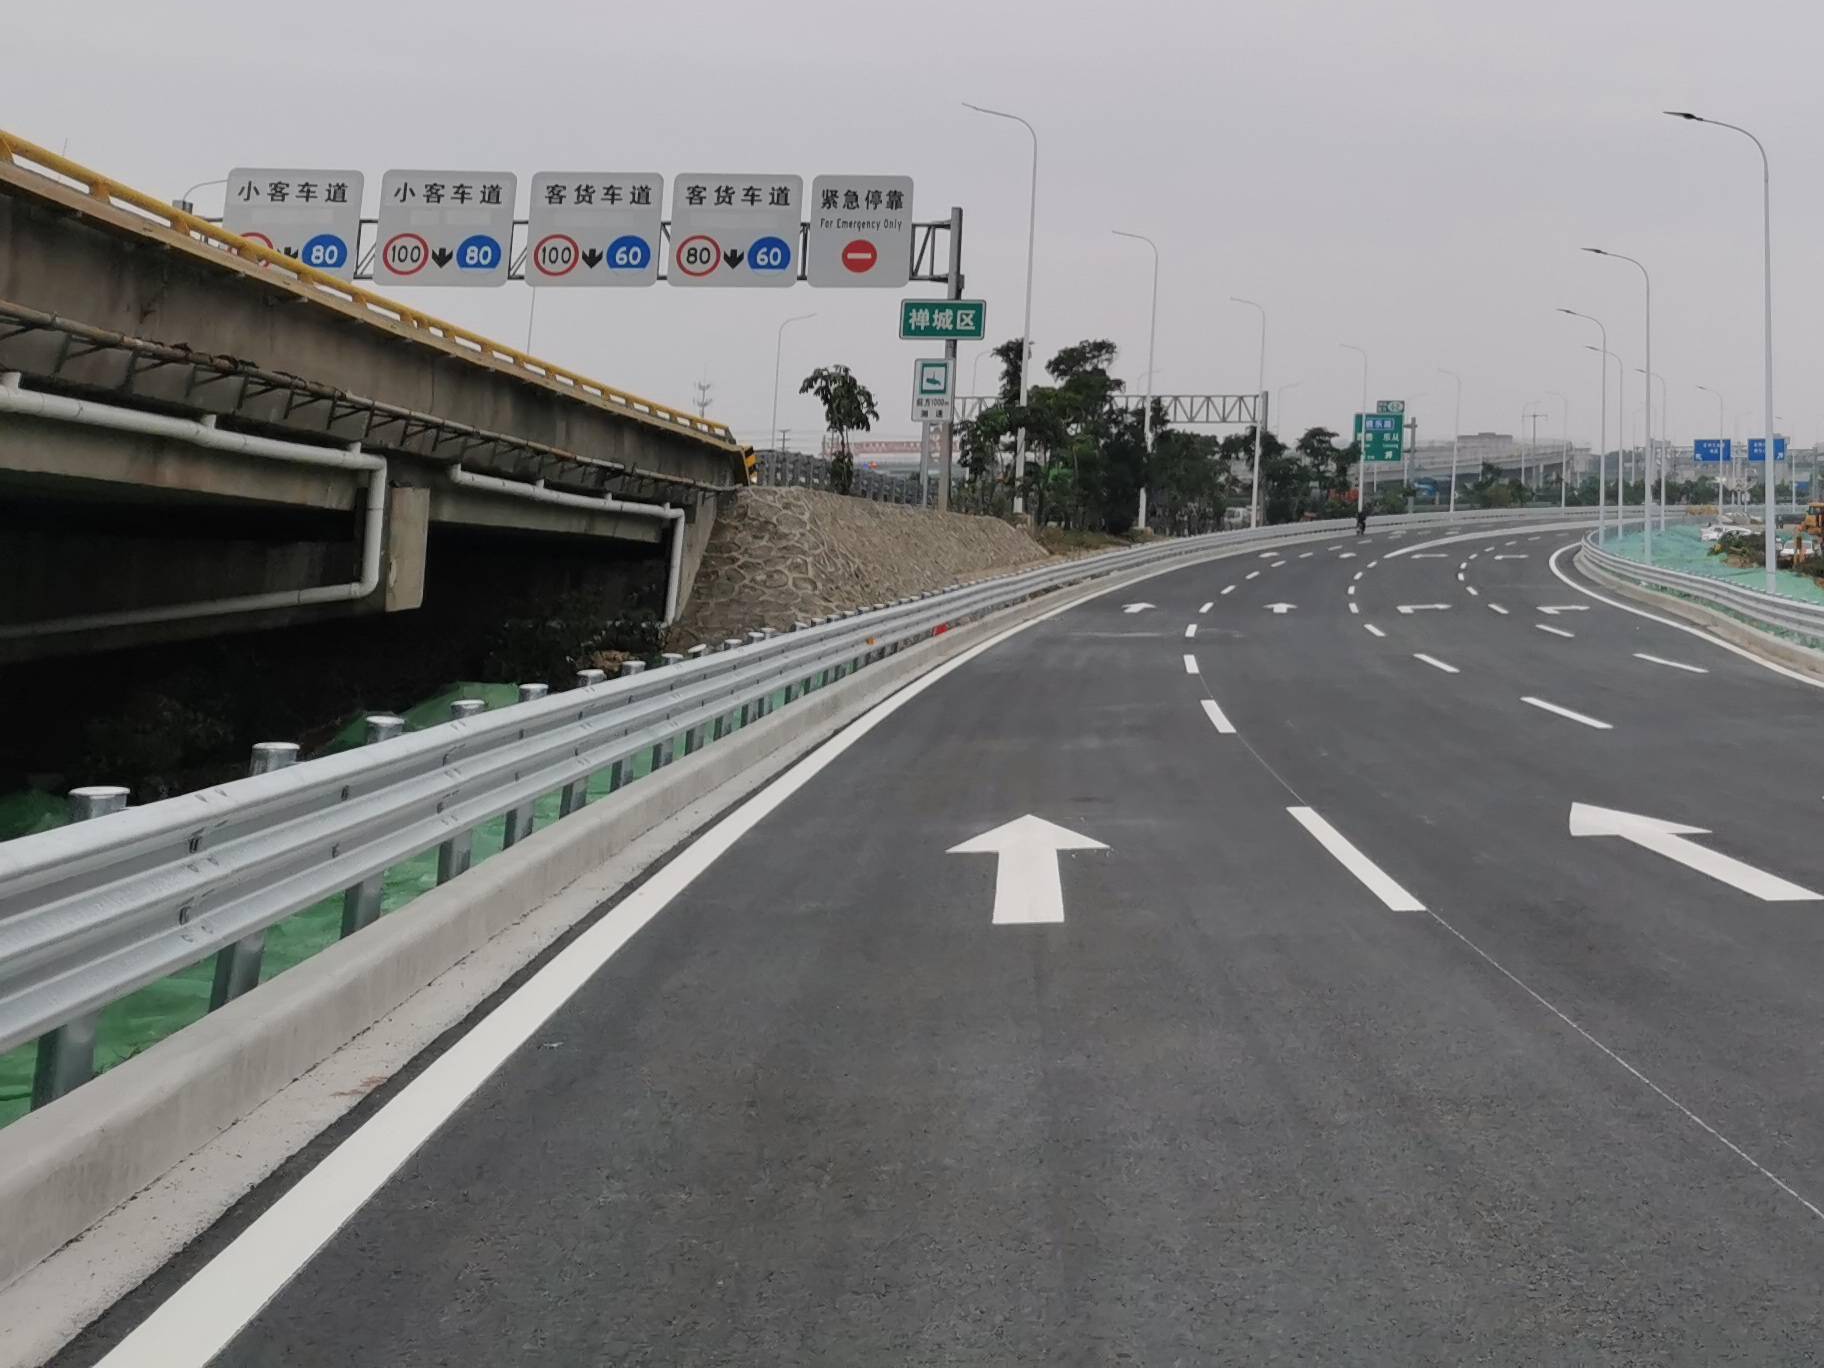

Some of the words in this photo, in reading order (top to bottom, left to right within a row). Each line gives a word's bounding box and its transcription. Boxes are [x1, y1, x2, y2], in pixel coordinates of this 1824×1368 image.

[238, 180, 348, 203] 小客车道
[394, 181, 502, 204] 小客车道
[545, 184, 652, 205] 客货车道
[686, 185, 790, 206] 客货车道
[821, 189, 904, 210] 紧急停靠
[820, 218, 833, 229] For
[837, 218, 880, 231] Emergency
[884, 218, 902, 231] Only
[310, 244, 338, 265] 80
[392, 245, 421, 263] 100
[466, 245, 492, 265] 80
[542, 246, 571, 264] 100
[615, 246, 642, 266] 60
[686, 247, 711, 265] 80
[756, 247, 782, 266] 60
[909, 308, 976, 330] 禅城区
